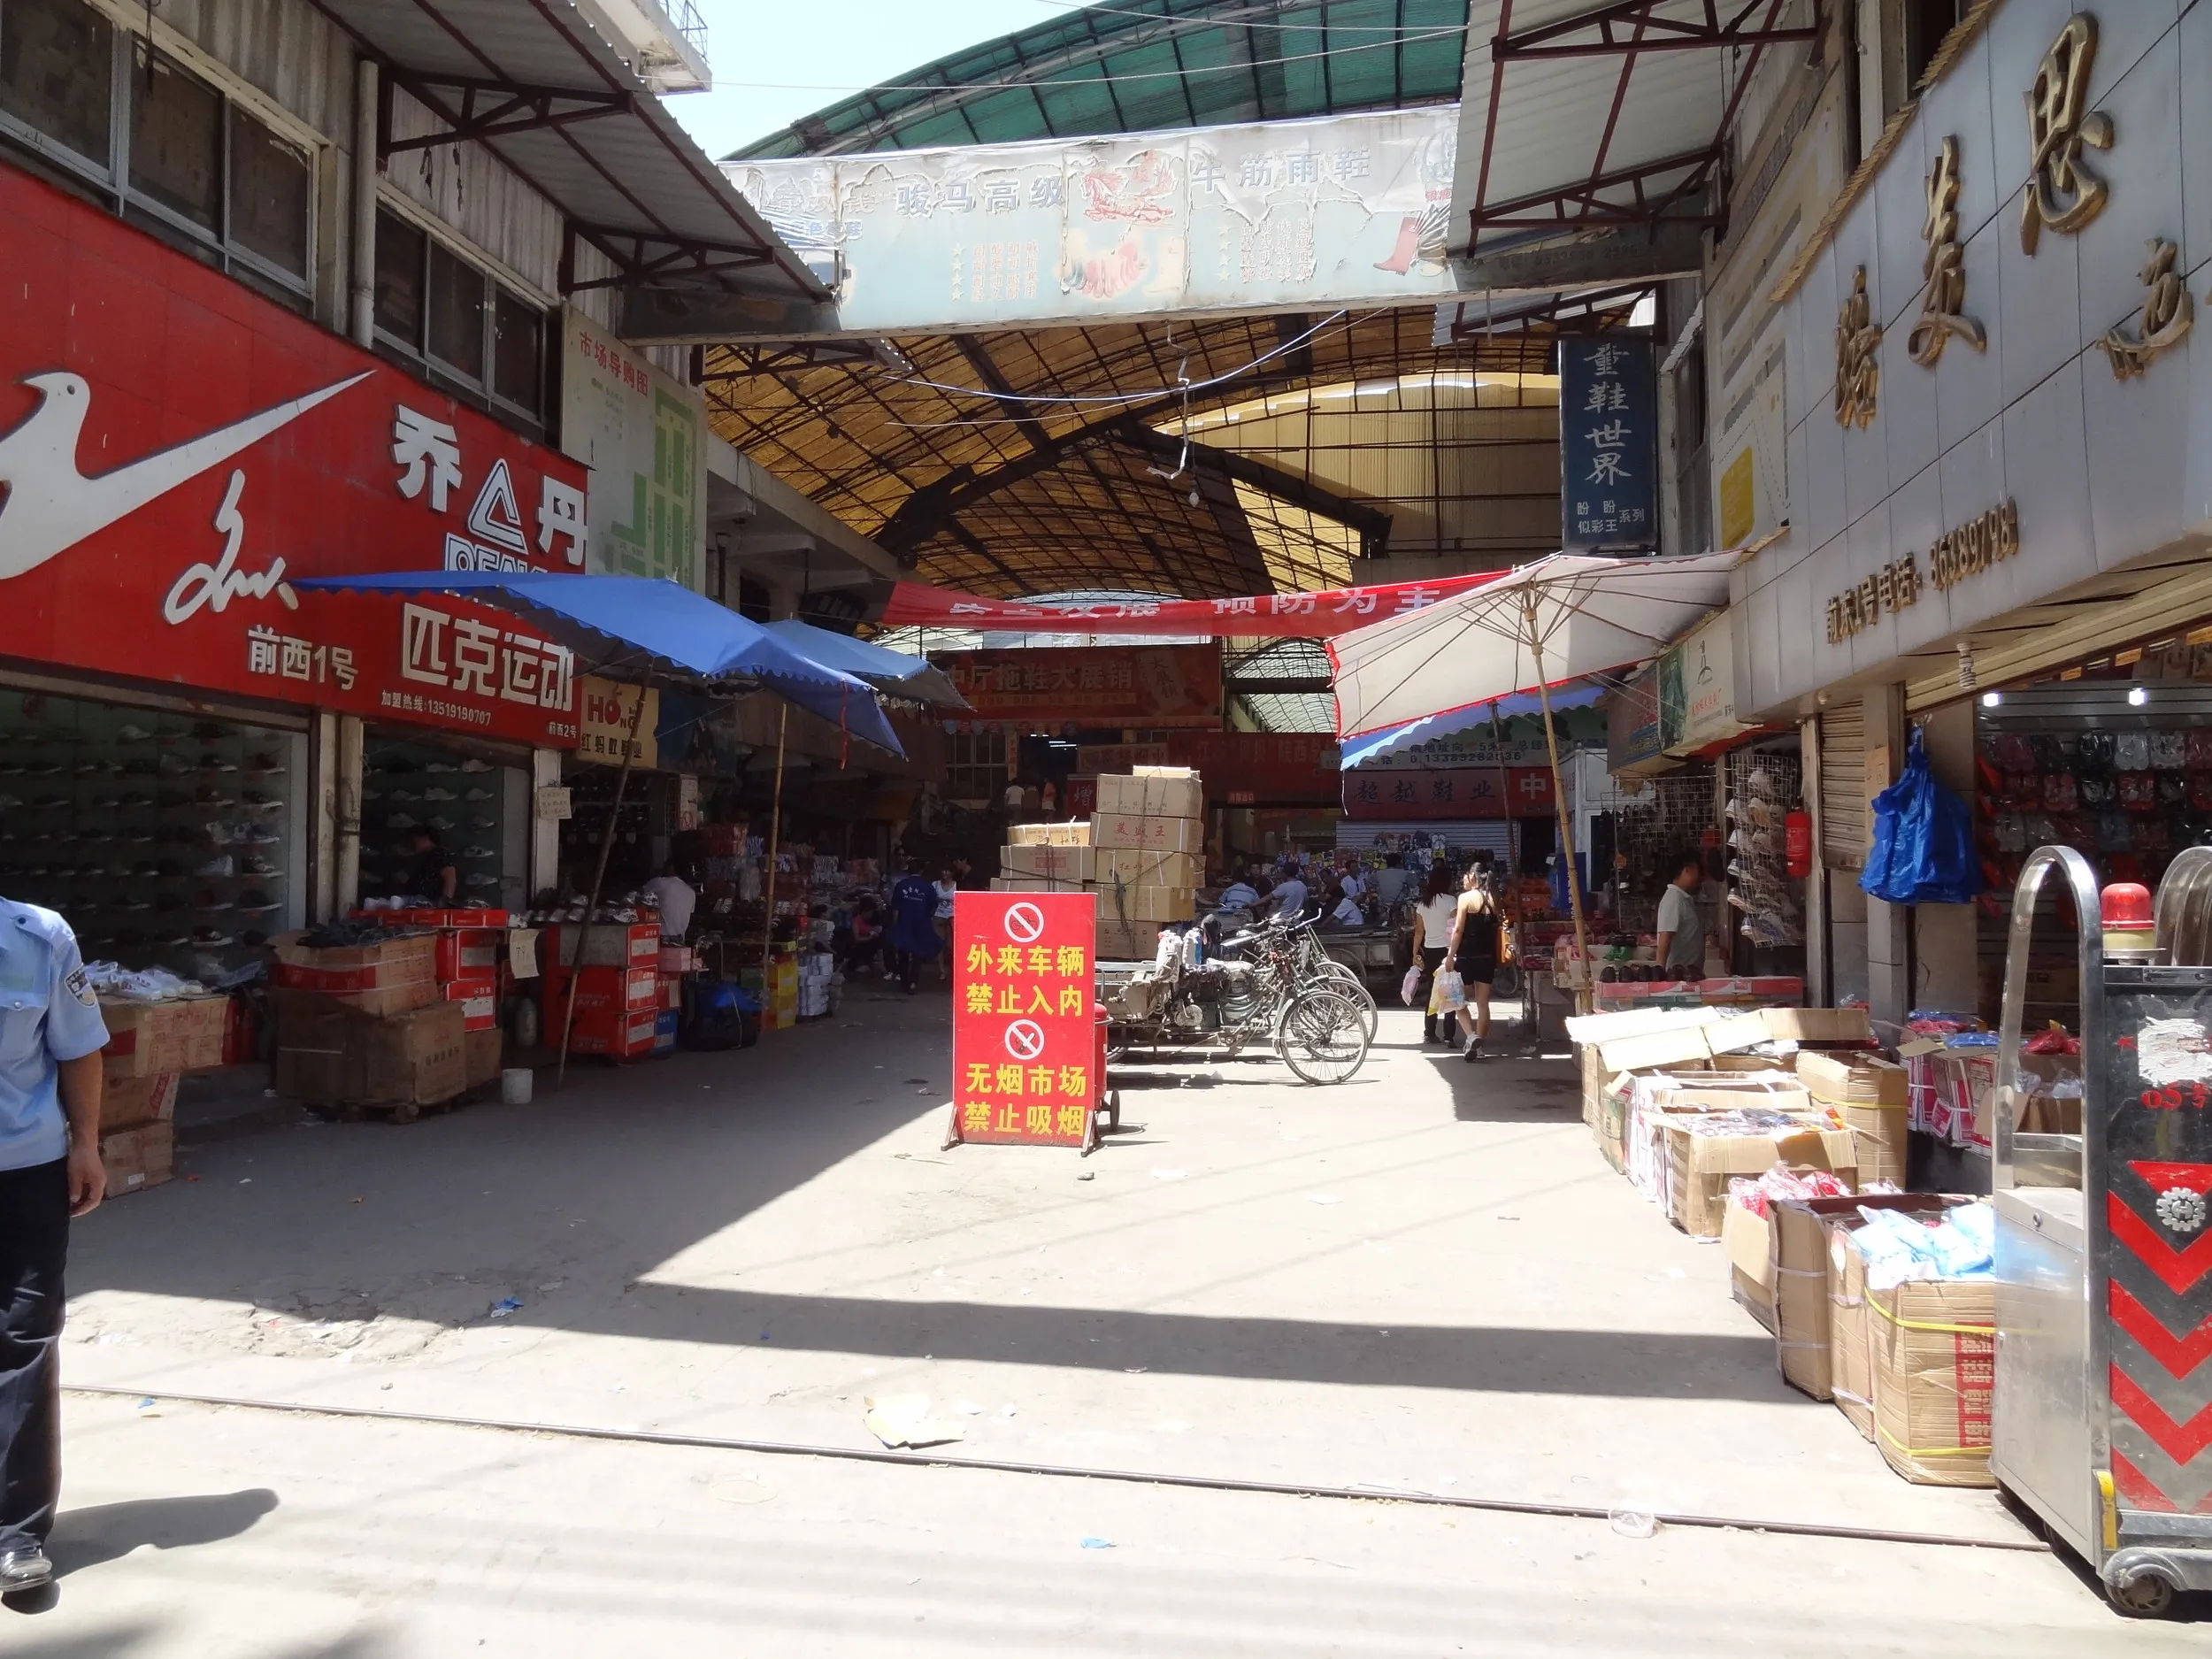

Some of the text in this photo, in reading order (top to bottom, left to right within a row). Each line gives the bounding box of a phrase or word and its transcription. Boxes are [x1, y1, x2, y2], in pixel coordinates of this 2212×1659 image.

[895, 174, 1064, 219] 骏马高级
[1191, 145, 1371, 194] 牛筋雨鞋
[580, 331, 648, 397] 市场导购图
[392, 403, 588, 567] 乔丹
[1577, 500, 1616, 516] 盼盼
[1619, 508, 1645, 524] 系列
[1210, 586, 1440, 615] 预防为主
[248, 624, 358, 691] 前西1号
[402, 603, 574, 711] 匹克运动
[949, 660, 1133, 692] 中厅拖鞋大展销
[547, 721, 577, 739] 前西2号
[1352, 778, 1496, 805] 超越鞋业
[1519, 772, 1547, 800] 中
[966, 943, 1085, 978] 外来车辆
[965, 982, 1083, 1017] 禁止入内
[965, 1063, 1087, 1097] 无烟市场
[964, 1101, 1086, 1138] 禁止吸烟
